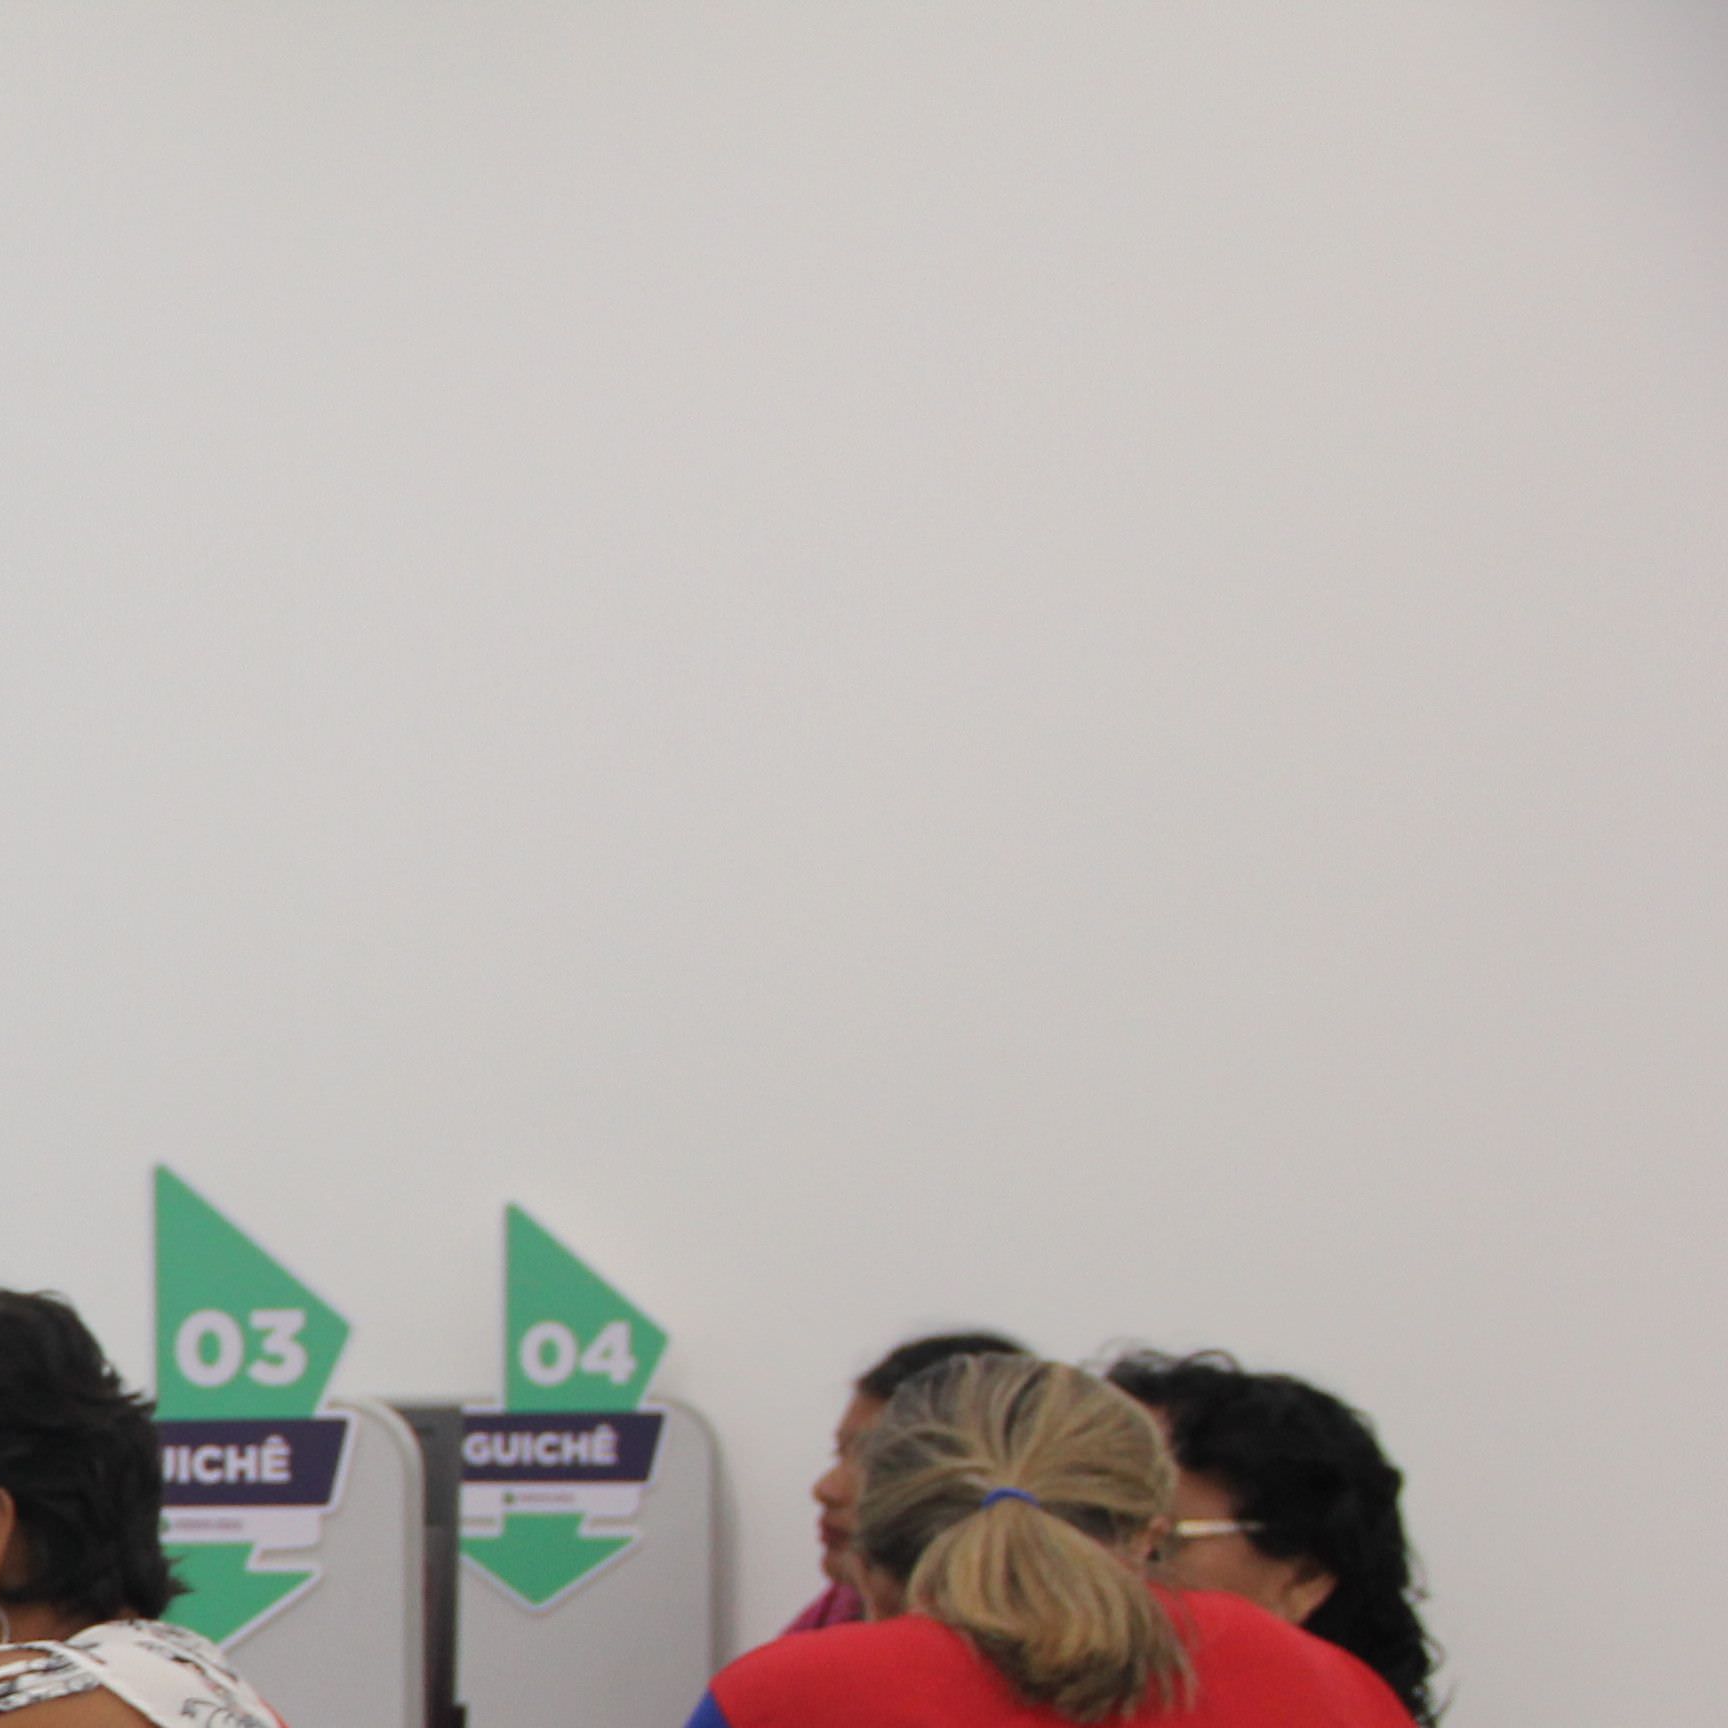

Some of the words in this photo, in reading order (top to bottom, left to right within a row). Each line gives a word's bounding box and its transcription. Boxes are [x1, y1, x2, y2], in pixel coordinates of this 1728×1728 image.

[174, 1308, 308, 1388] 03
[520, 1321, 636, 1387] 04
[461, 1425, 618, 1467] GUICHÊ
